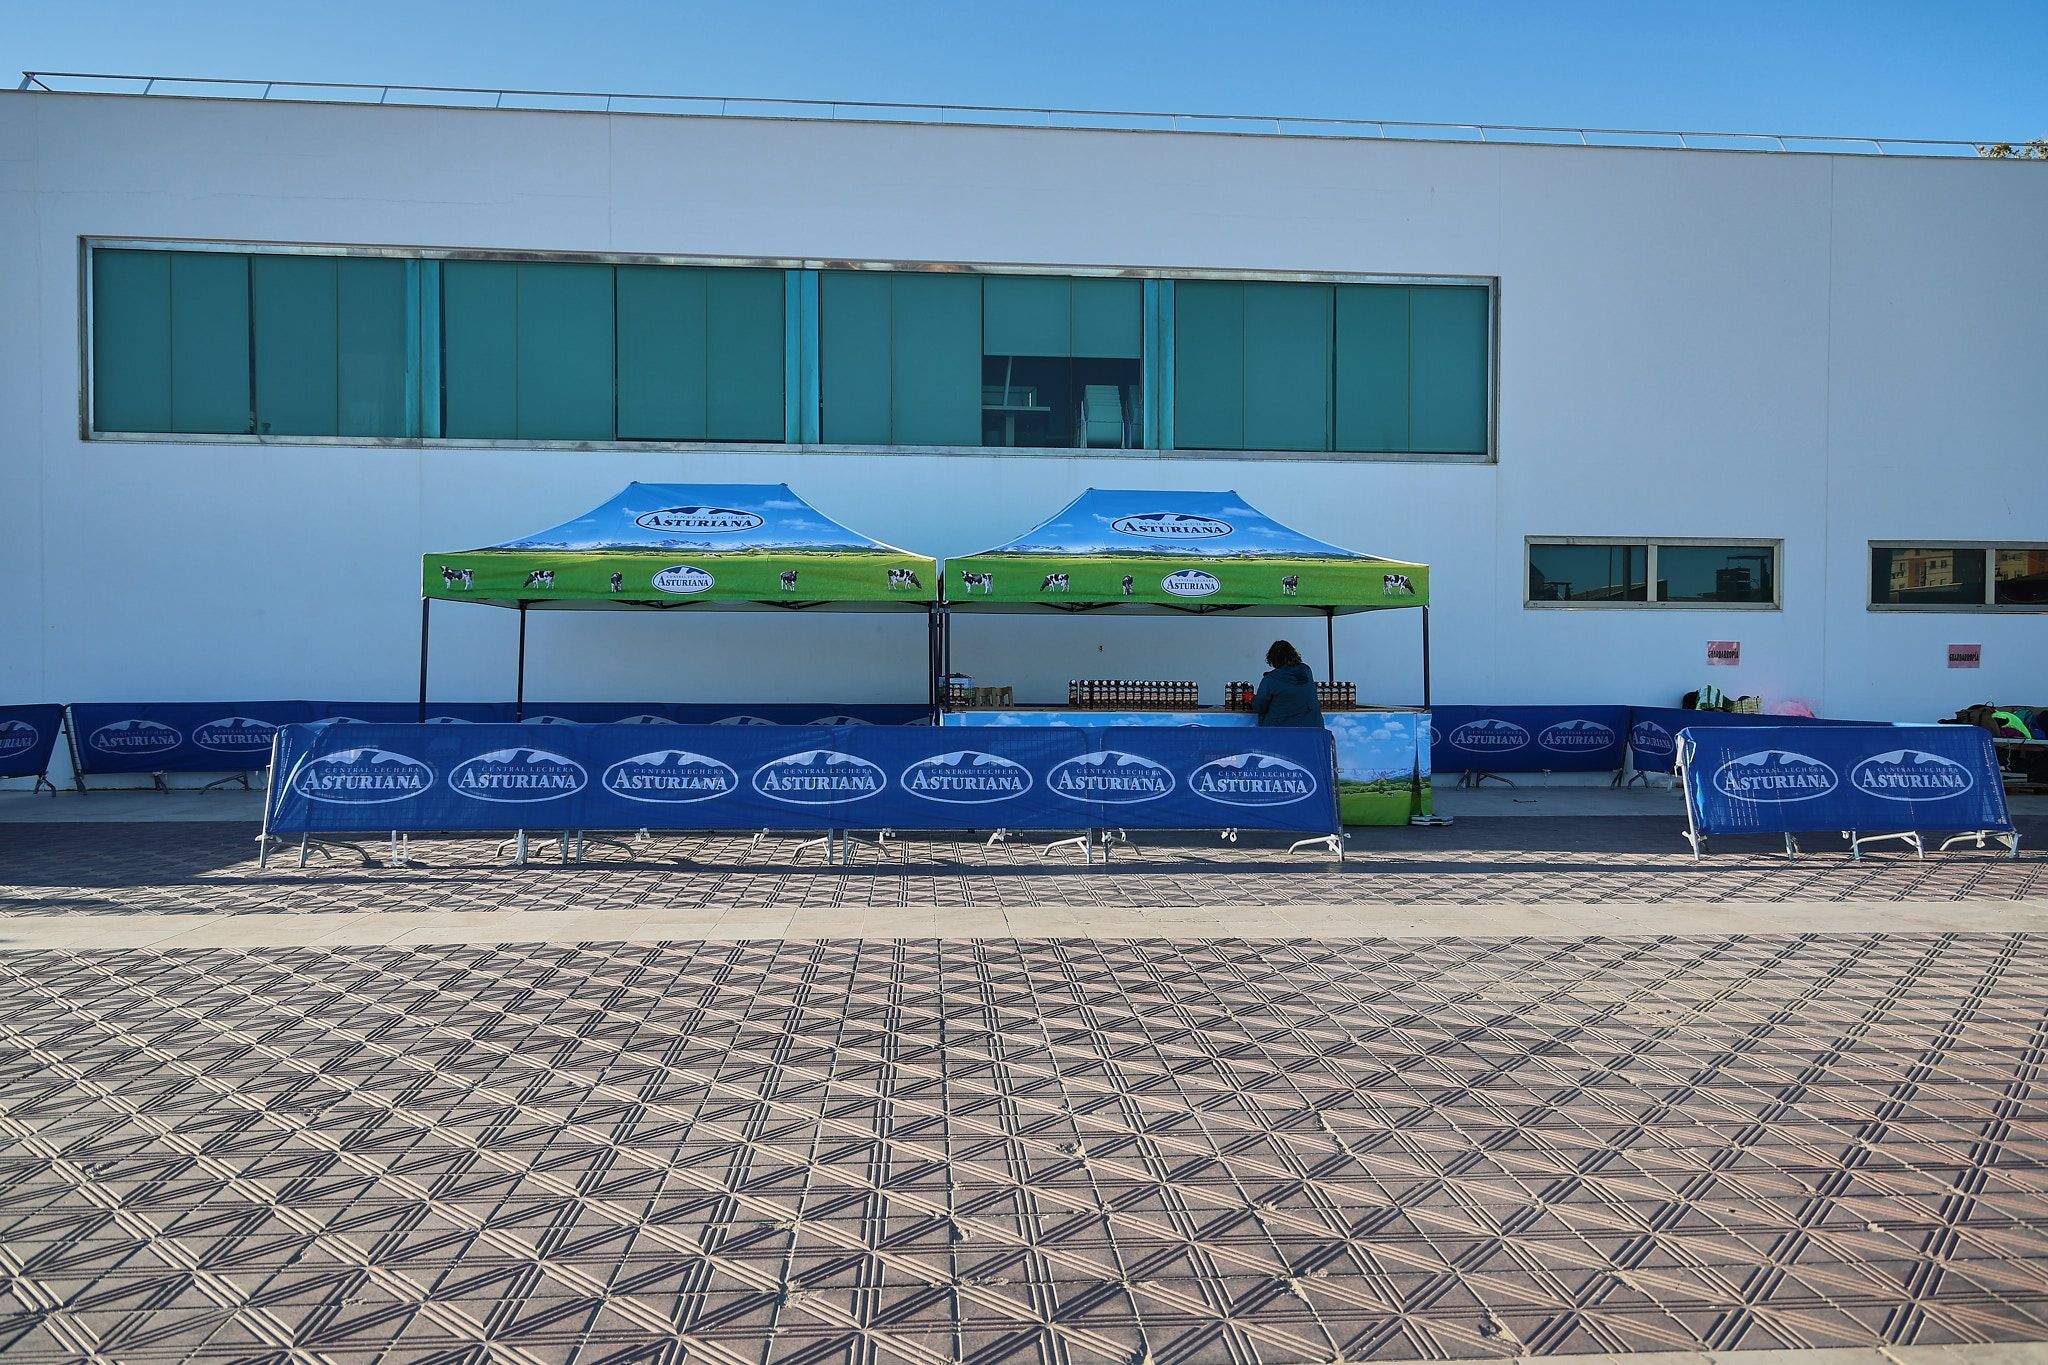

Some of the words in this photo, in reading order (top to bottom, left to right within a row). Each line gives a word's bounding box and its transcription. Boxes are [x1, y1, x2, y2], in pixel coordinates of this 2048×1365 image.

[646, 515, 753, 527] ASTURIANA
[1123, 521, 1224, 533] ASTURIANA
[657, 575, 709, 586] ASTURIANA
[1167, 579, 1215, 590] ASTURIANA
[98, 733, 176, 748] ASTURIANA
[200, 730, 273, 744] ASTURIAN
[1454, 730, 1524, 745] ASTURIANA
[1543, 731, 1609, 745] ASTURIANA
[300, 768, 422, 790] ASTURIANA
[458, 767, 577, 789] ASTURIANA
[612, 768, 728, 790] ASTURIANA
[761, 769, 877, 791] ASTURIANA
[910, 769, 1023, 790] ASTURIANA
[1056, 769, 1166, 791] ASTURIANA
[1199, 771, 1309, 794] ASTURIANA
[1723, 770, 1831, 791] ASTURIANA
[1861, 768, 1966, 788] ASTURIANA
